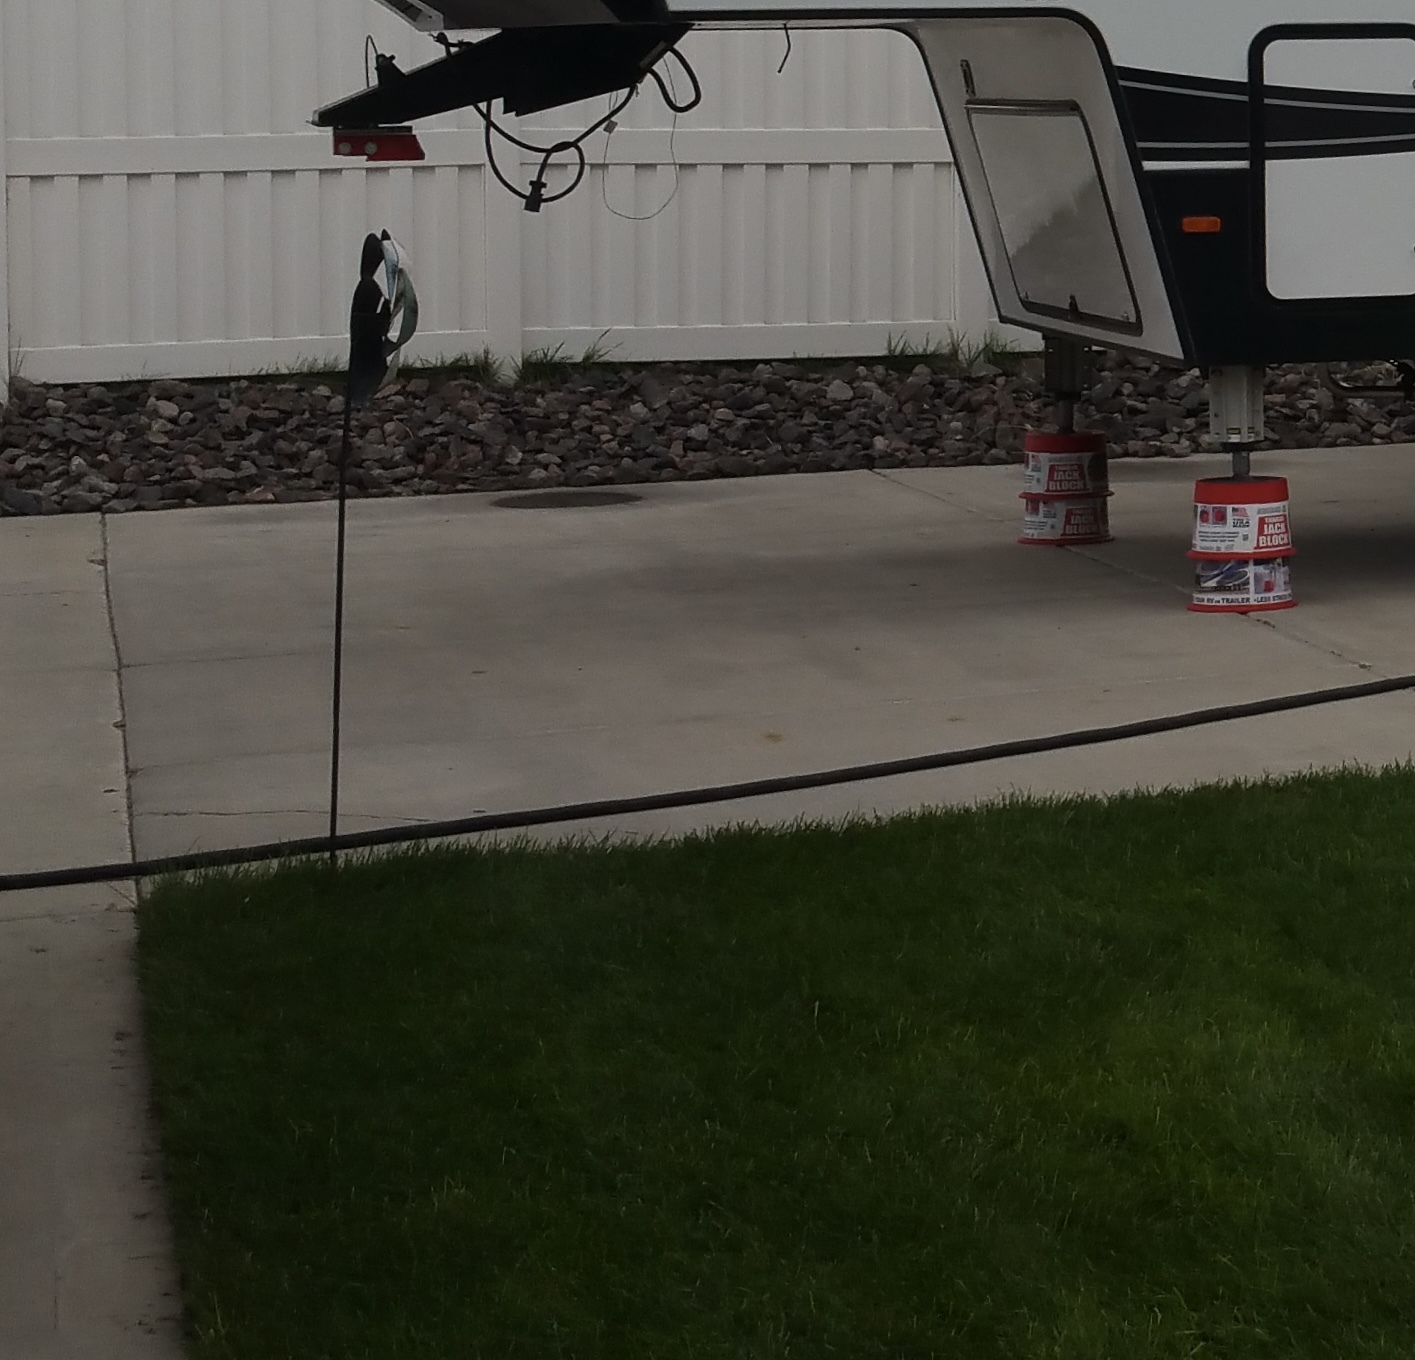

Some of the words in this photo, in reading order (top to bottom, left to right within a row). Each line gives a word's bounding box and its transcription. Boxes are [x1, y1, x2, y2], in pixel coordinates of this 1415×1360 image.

[1053, 470, 1080, 481] JACK
[1049, 481, 1085, 491] BLOCK
[1071, 515, 1095, 525] JACK
[1263, 522, 1286, 535] JACK
[1259, 533, 1288, 546] BLOCK
[1221, 596, 1251, 604] TRAILER
